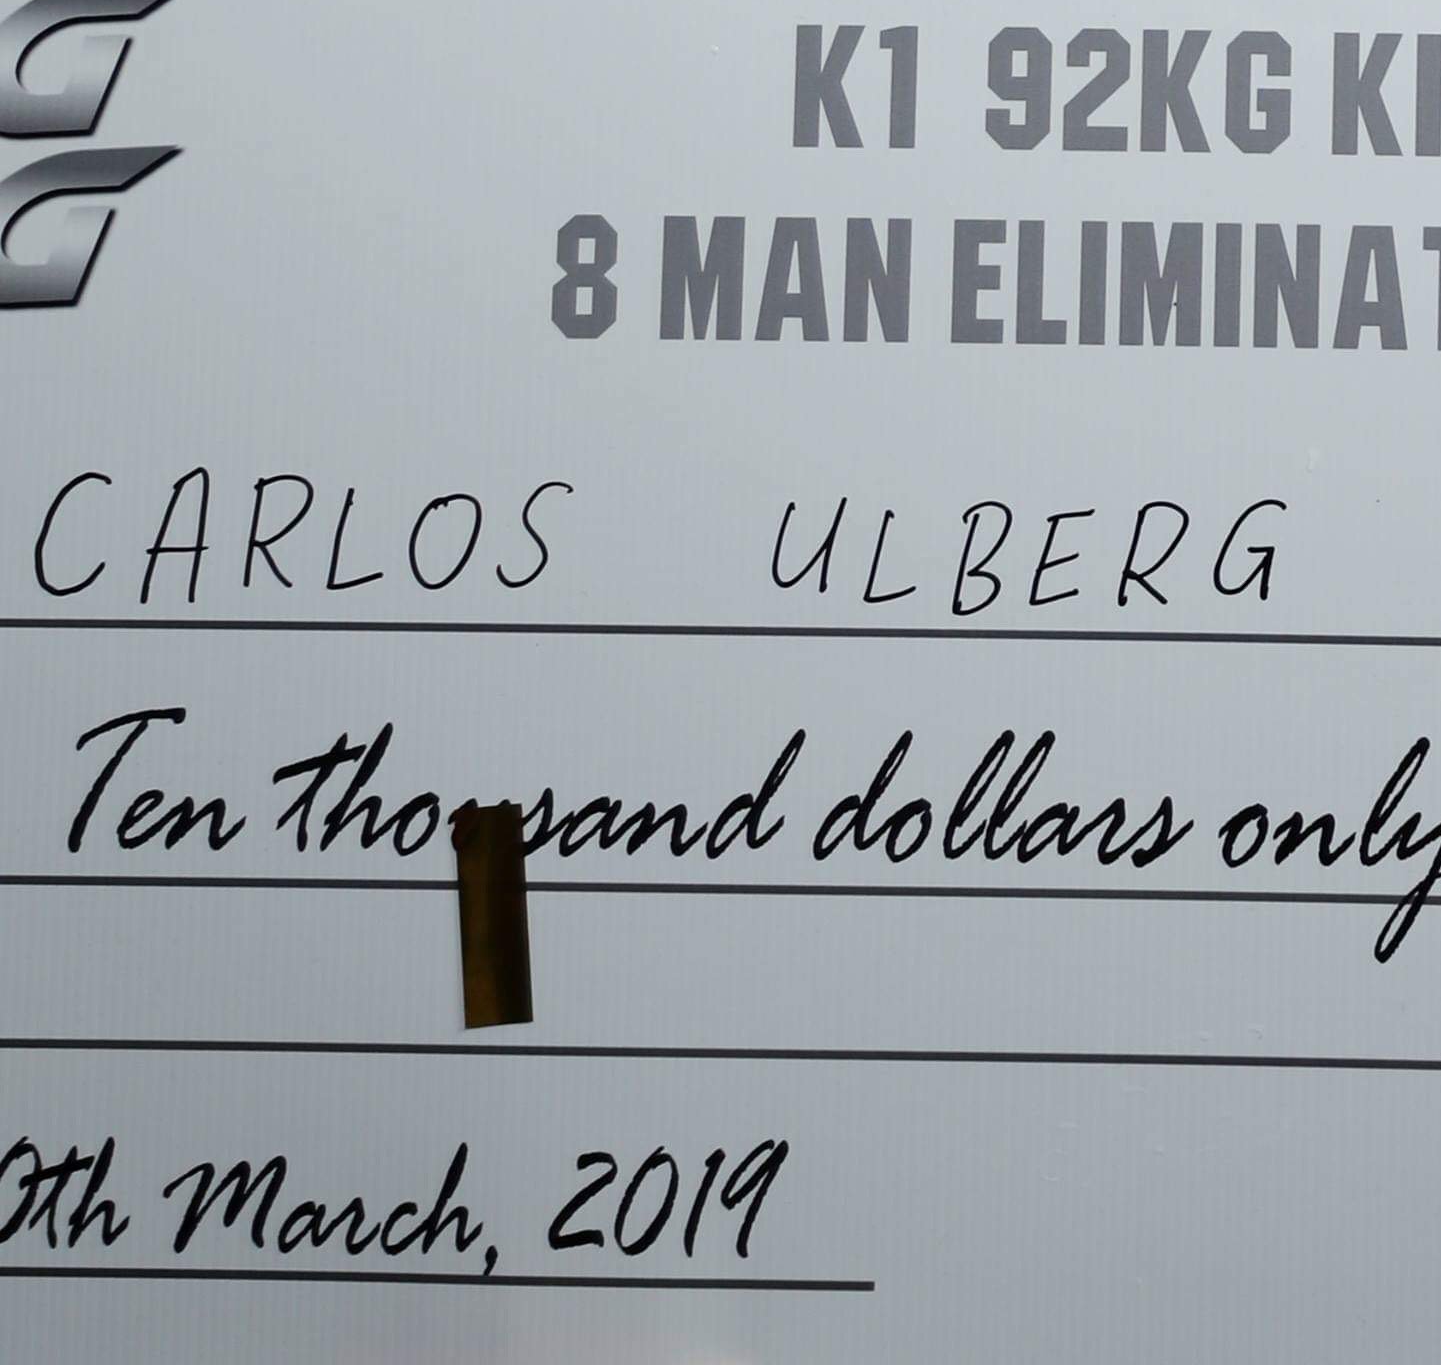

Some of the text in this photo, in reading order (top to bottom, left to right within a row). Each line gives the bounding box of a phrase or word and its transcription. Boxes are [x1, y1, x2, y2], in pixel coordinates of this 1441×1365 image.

[793, 24, 919, 149] K1
[985, 27, 1292, 154] 92KG
[550, 214, 618, 340] 8
[659, 216, 912, 343] MAN
[34, 467, 1287, 616] CARLOS ULBERG
[67, 707, 248, 855] Ten
[272, 722, 806, 857] thosand
[812, 729, 1195, 869] dollars
[163, 1142, 498, 1274] March,
[547, 1139, 789, 1259] 2019
